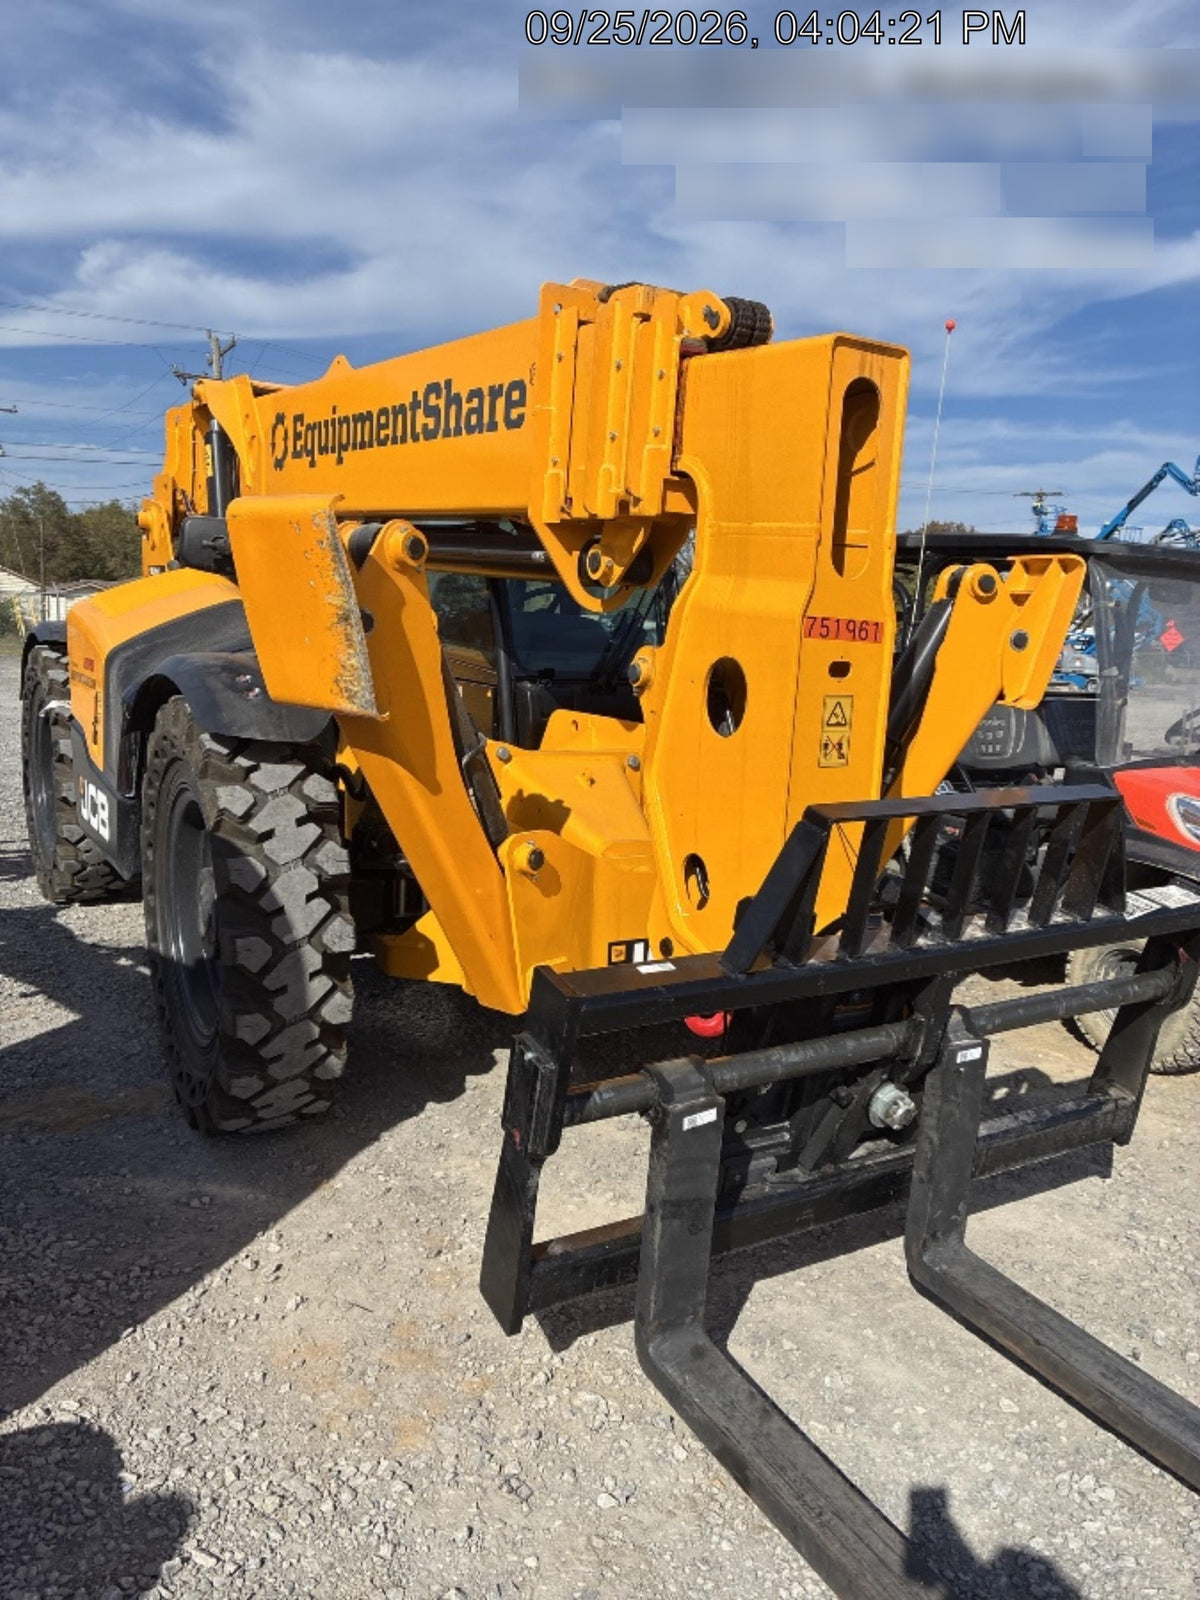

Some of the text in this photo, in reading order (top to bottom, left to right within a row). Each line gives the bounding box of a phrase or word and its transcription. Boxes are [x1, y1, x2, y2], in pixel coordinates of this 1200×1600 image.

[291, 378, 527, 468] EquipmentShare
[806, 616, 880, 643] 751961
[80, 779, 110, 843] JCB
